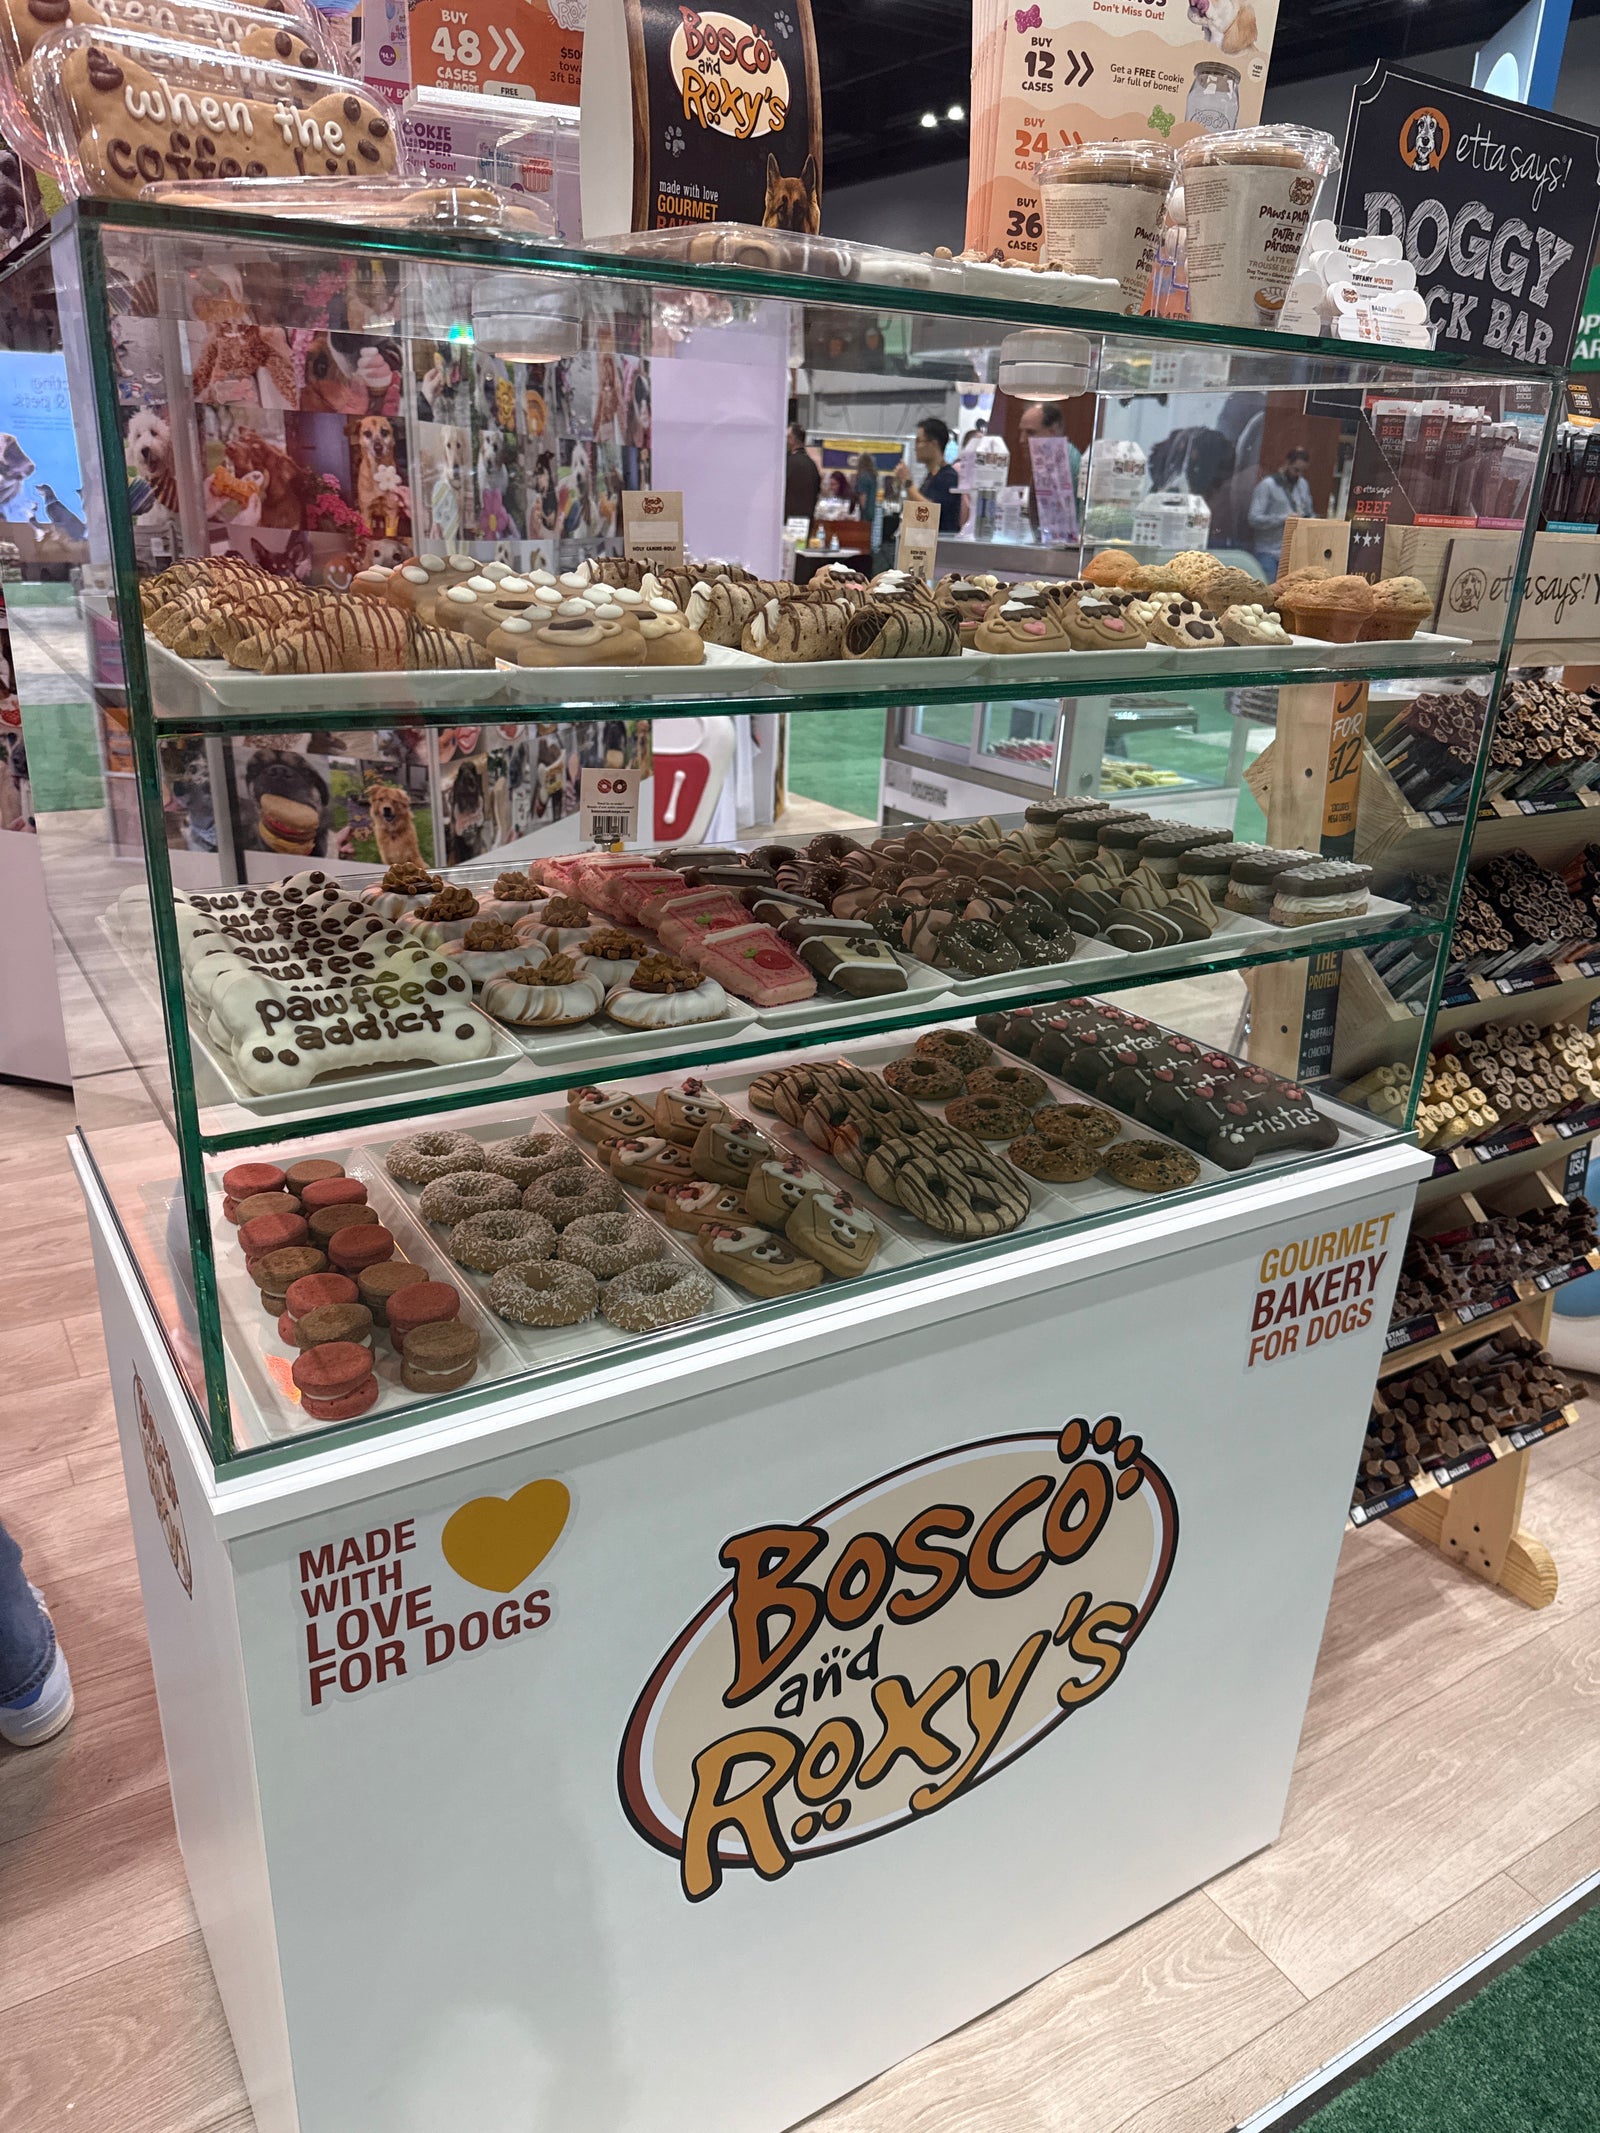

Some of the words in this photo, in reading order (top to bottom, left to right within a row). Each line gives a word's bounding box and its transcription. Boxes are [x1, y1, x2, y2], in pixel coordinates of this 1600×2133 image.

[441, 9, 468, 25] BUY
[1093, 1, 1120, 14] Don't
[1122, 6, 1143, 17] Miss
[1145, 9, 1166, 21] Out!
[431, 26, 482, 66] 48
[678, 5, 774, 76] Bosco
[1031, 37, 1053, 48] BUY
[436, 66, 478, 83] CASES
[698, 57, 722, 77] and
[1024, 51, 1056, 79] 12
[1110, 63, 1126, 75] Get
[1134, 67, 1156, 79] FREE
[1157, 71, 1185, 84] Cookie
[550, 71, 566, 83] 3ft
[1021, 81, 1054, 93] CASES
[1112, 74, 1126, 84] Jar
[1127, 76, 1142, 88] full
[1142, 79, 1152, 89] of
[1152, 80, 1179, 94] bones!
[500, 86, 519, 97] FREE
[682, 67, 787, 140] Roxy's
[125, 78, 254, 138] when
[273, 102, 347, 156] the
[1023, 117, 1046, 128] BUY
[402, 122, 452, 141] OOKIE
[1014, 129, 1050, 157] 24
[429, 159, 457, 171] Soon!
[1014, 160, 1037, 171] CAS
[1456, 122, 1506, 173] etta
[1509, 144, 1573, 213] says!
[659, 180, 681, 194] made
[683, 183, 700, 199] with
[702, 186, 719, 202] love
[657, 194, 719, 221] GOURMET
[1016, 197, 1038, 208] BUY
[1258, 205, 1286, 220] PAWS
[1006, 210, 1043, 239] 36
[1007, 239, 1038, 251] CASES
[1338, 244, 1351, 254] ALEX
[1351, 247, 1368, 257] LEWIS
[1363, 190, 1576, 309] DOGGY
[1352, 273, 1373, 283] TIFFANY
[1482, 297, 1554, 365] BAR
[1381, 426, 1403, 436] BEE
[1355, 501, 1392, 514] BEEF
[1489, 565, 1533, 603] eta
[1332, 711, 1364, 742] FOR
[1328, 735, 1363, 785] $12
[205, 934, 360, 965] awfee
[216, 951, 376, 981] wfee
[1315, 951, 1338, 972] THE
[1308, 970, 1340, 991] PROTEIN
[255, 981, 425, 1037] pawfee
[1311, 1007, 1327, 1021] BEEF
[294, 1003, 445, 1051] addict
[1308, 1024, 1334, 1040] BUFFALO
[1307, 1044, 1331, 1059] CHICKEN
[1304, 1064, 1321, 1078] DEER
[1569, 1120, 1589, 1133] Select
[1488, 1143, 1509, 1157] Select
[1568, 1157, 1585, 1176] USA
[1259, 1211, 1396, 1285] GOURMET
[1250, 1250, 1389, 1333] BAKERY
[1247, 1324, 1301, 1368] FOR
[1305, 1297, 1375, 1347] DOGS
[1524, 1428, 1544, 1443] DELUXE
[1449, 1462, 1471, 1479] DELUXE
[1365, 1500, 1389, 1518] DELUXE
[298, 1517, 417, 1584] MADE
[300, 1559, 403, 1619] WITH
[719, 1458, 1113, 1709] Bosco
[306, 1584, 434, 1664] LOVE
[308, 1639, 408, 1707] FOR
[424, 1588, 552, 1667] DOGS
[774, 1624, 885, 1719] and
[679, 1591, 1139, 1904] Roxy's
